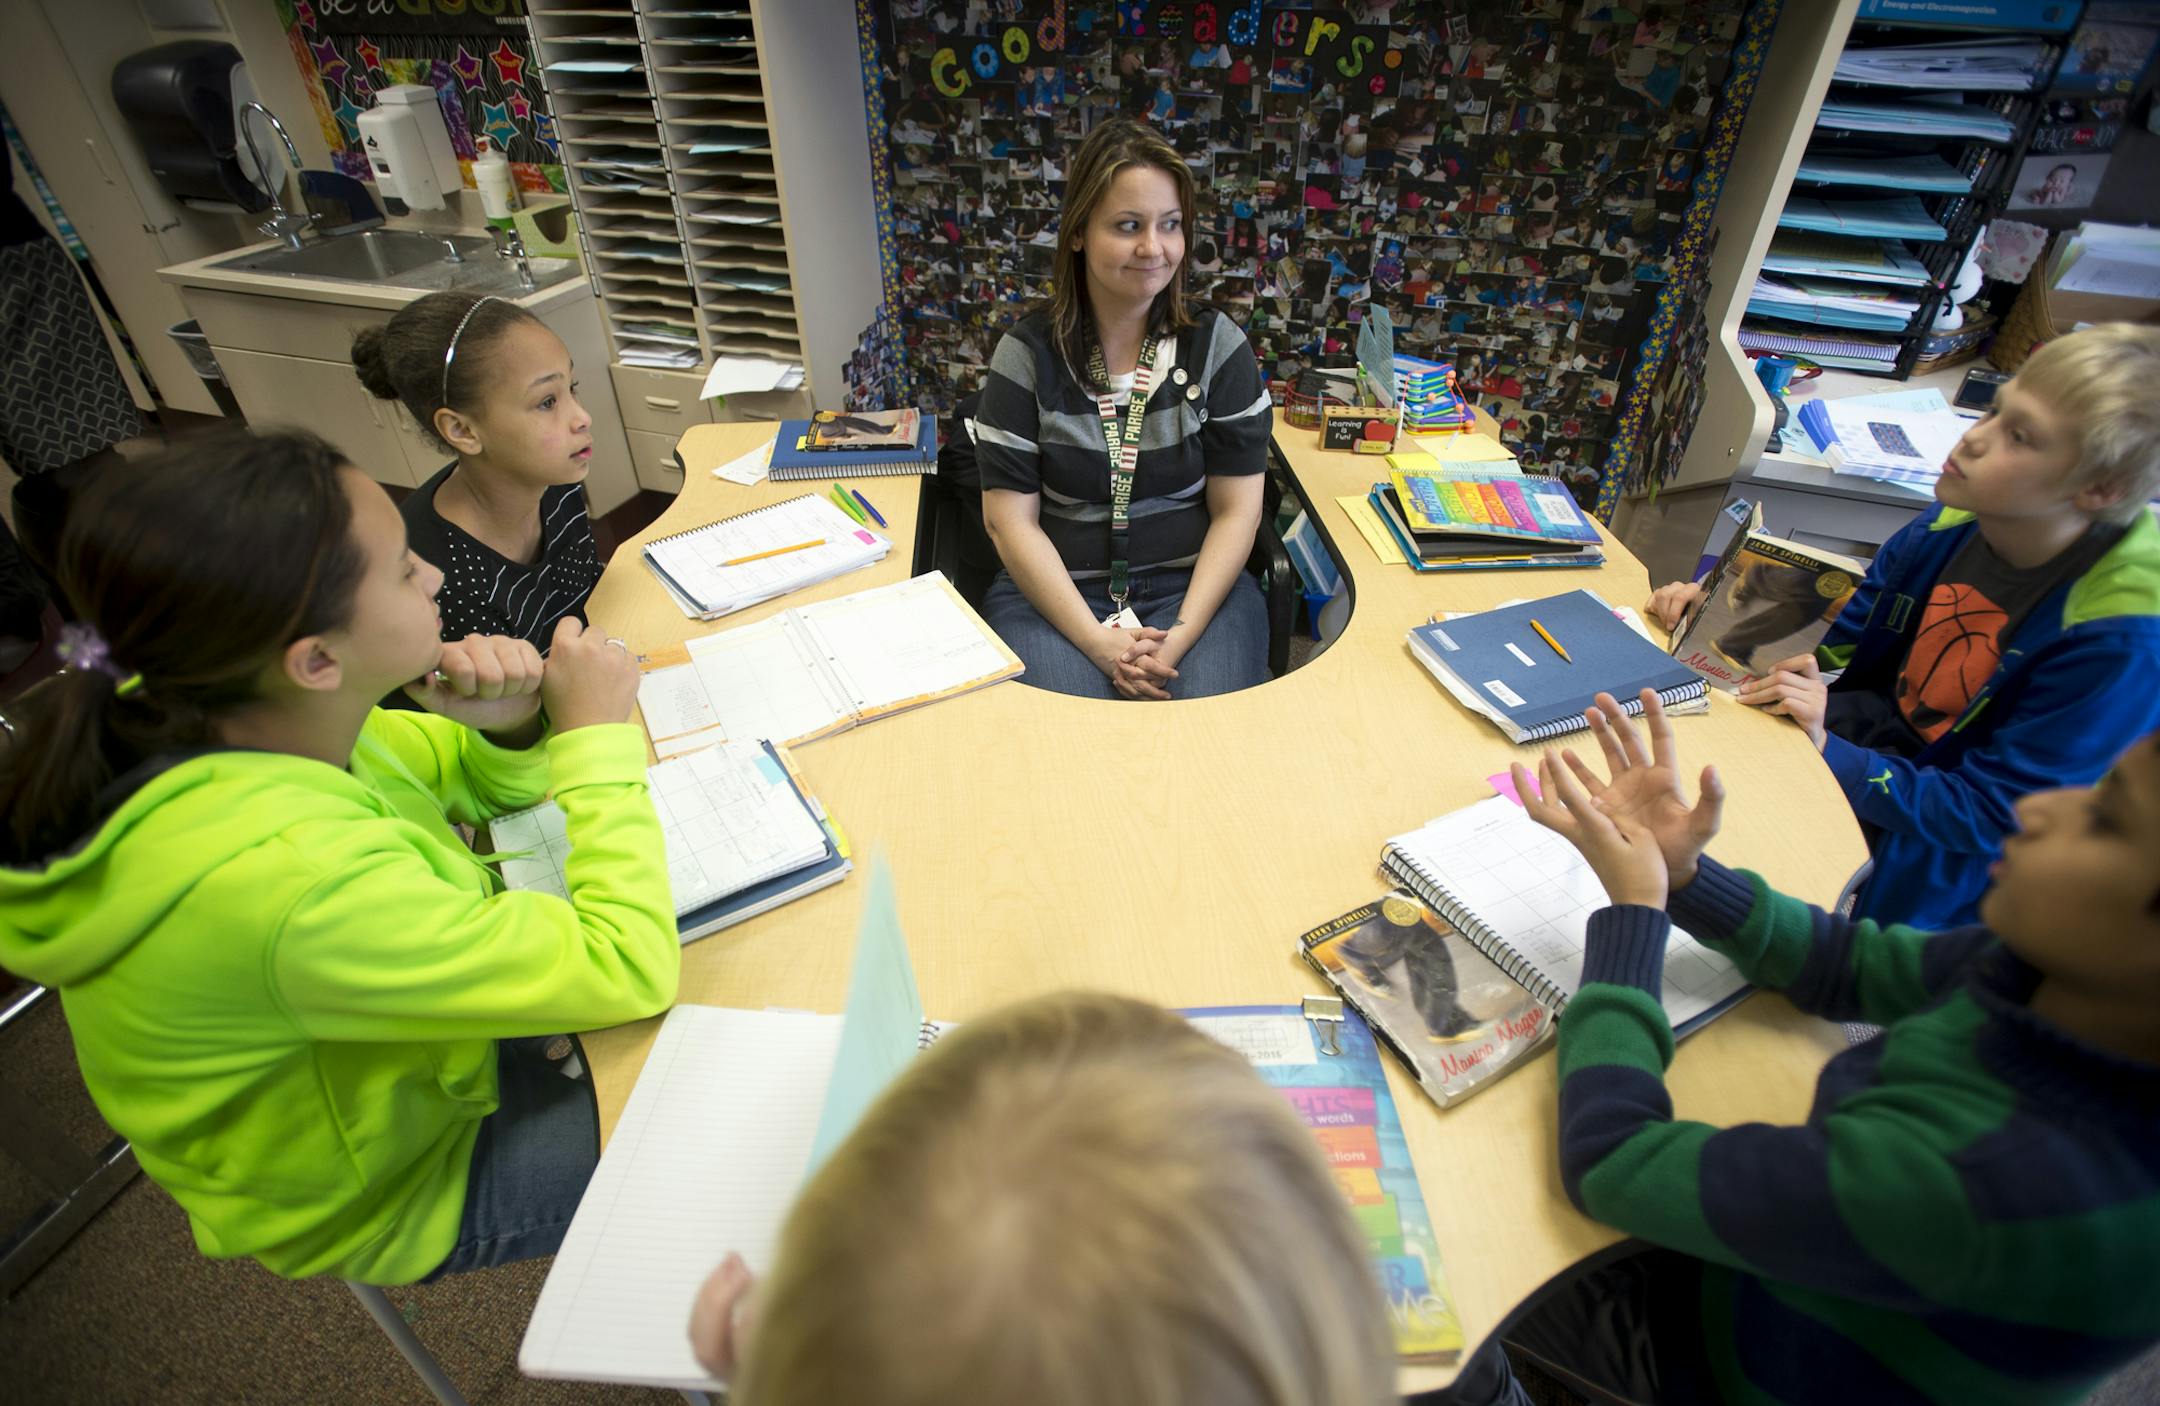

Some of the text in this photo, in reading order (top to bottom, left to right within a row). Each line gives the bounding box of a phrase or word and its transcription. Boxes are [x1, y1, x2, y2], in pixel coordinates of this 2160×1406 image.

[930, 0, 1065, 97] Good
[1135, 373, 1151, 386] 11
[1124, 395, 1147, 442] PARISE
[1328, 420, 1362, 429] Learning
[1103, 422, 1121, 468] PARISE
[1113, 475, 1133, 519] PARISE
[1779, 549, 1820, 568] SPINELLI
[1306, 924, 1334, 943] JERRY
[1333, 907, 1372, 931] SPINELLI
[1494, 1007, 1545, 1044] Magee
[1317, 1111, 1355, 1124] words
[1325, 1149, 1367, 1163] ctions
